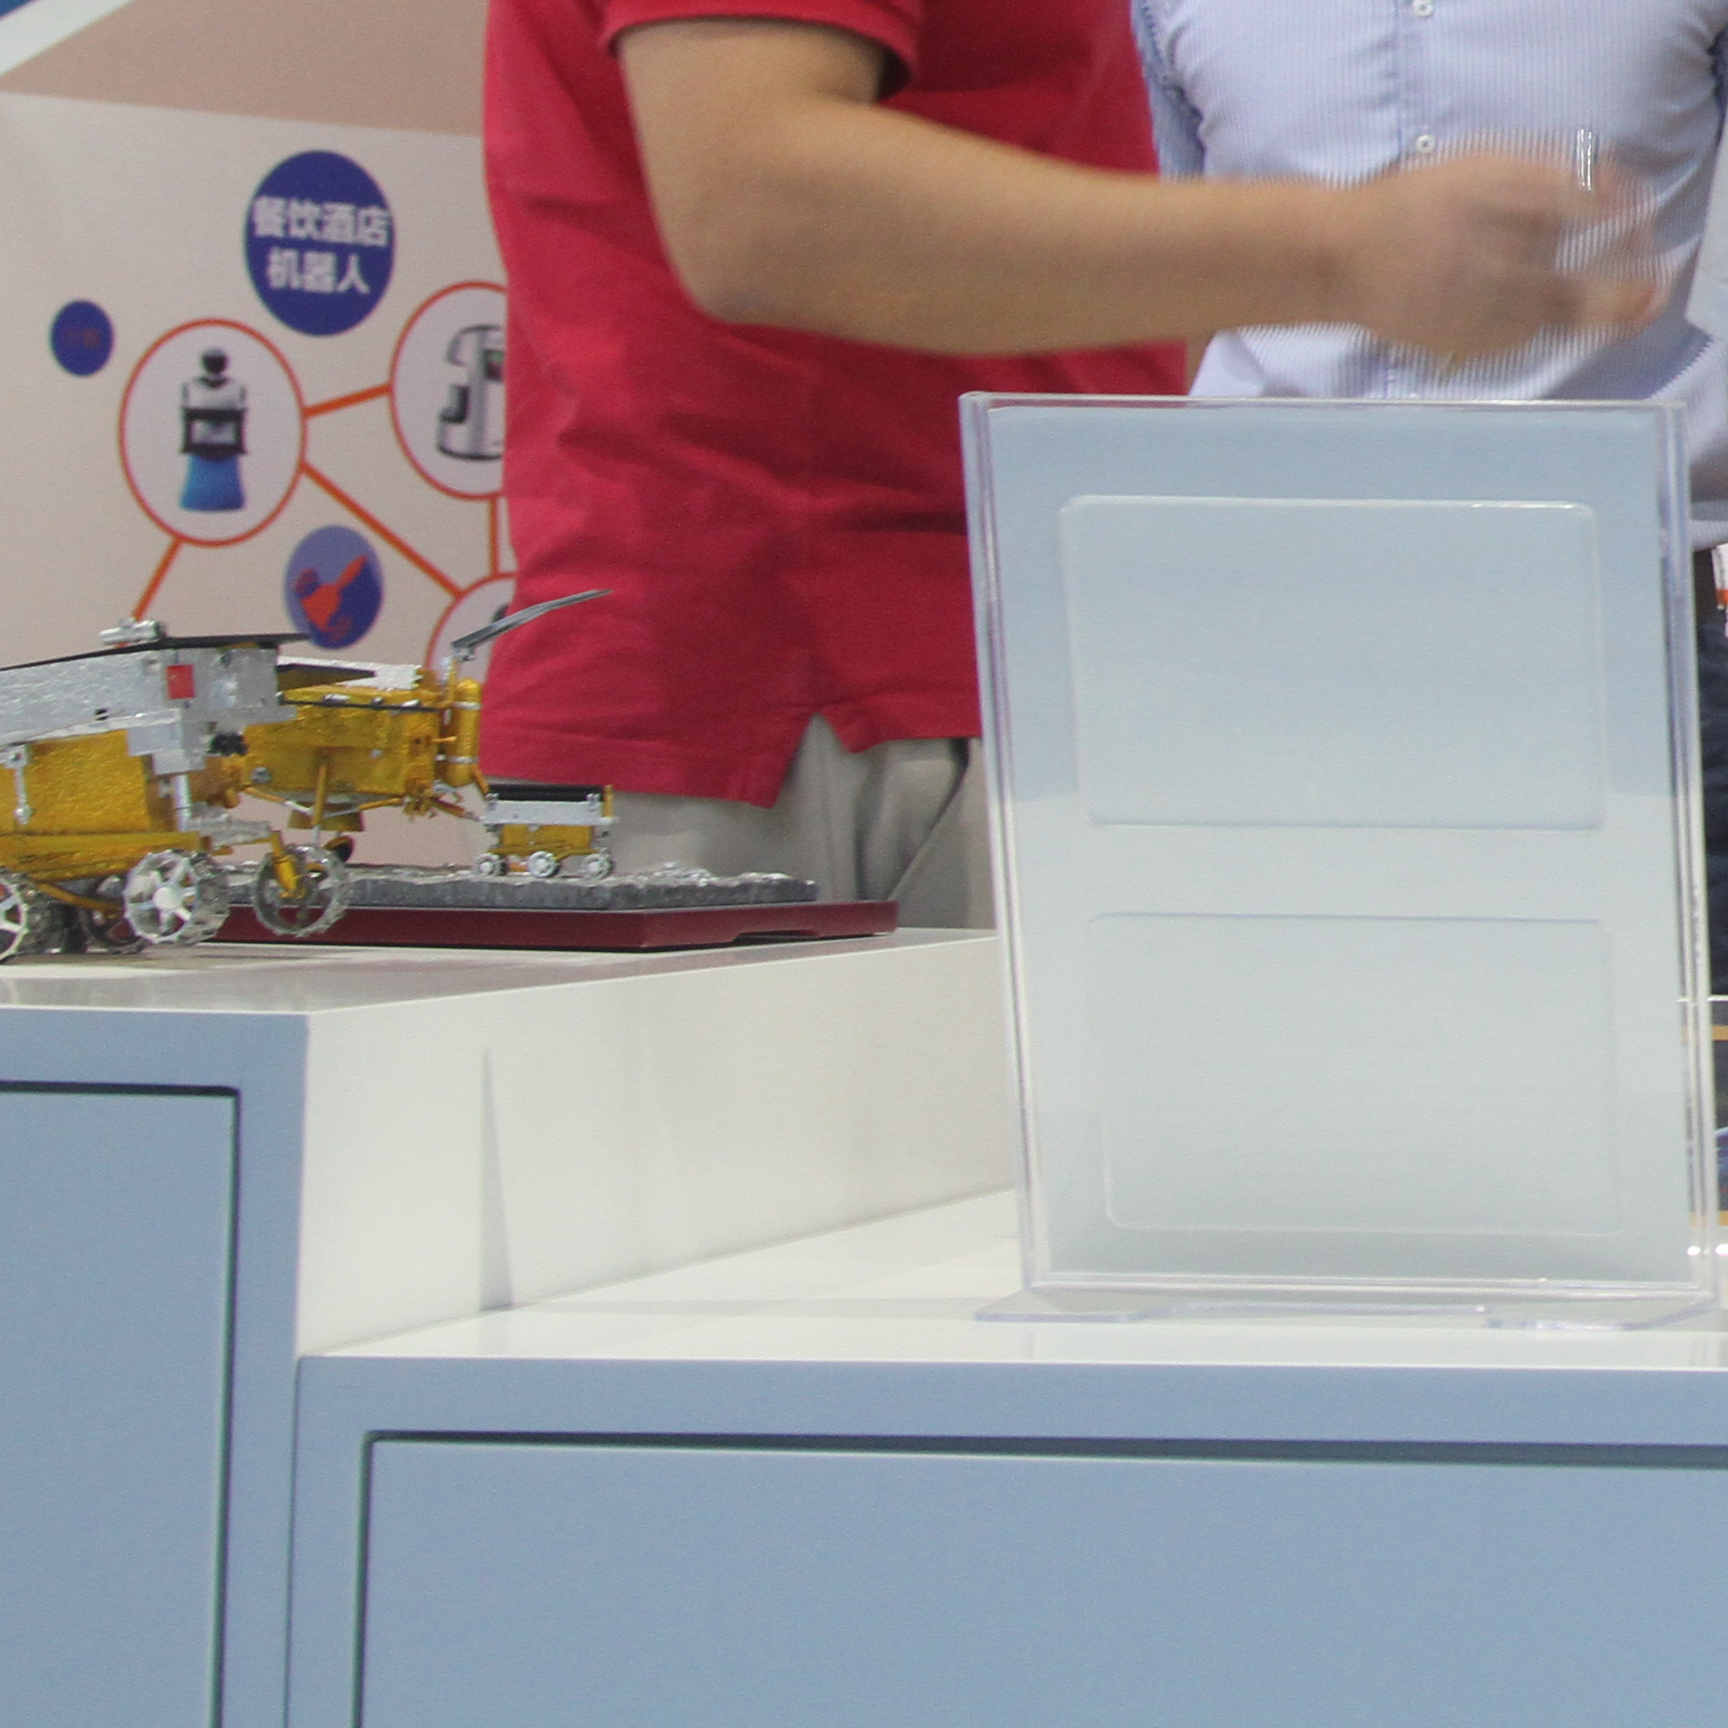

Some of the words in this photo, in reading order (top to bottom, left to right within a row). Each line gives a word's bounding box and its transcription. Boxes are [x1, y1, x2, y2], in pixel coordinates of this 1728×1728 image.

[253, 195, 388, 247] 餐饮酒店
[267, 247, 371, 294] 机器人
